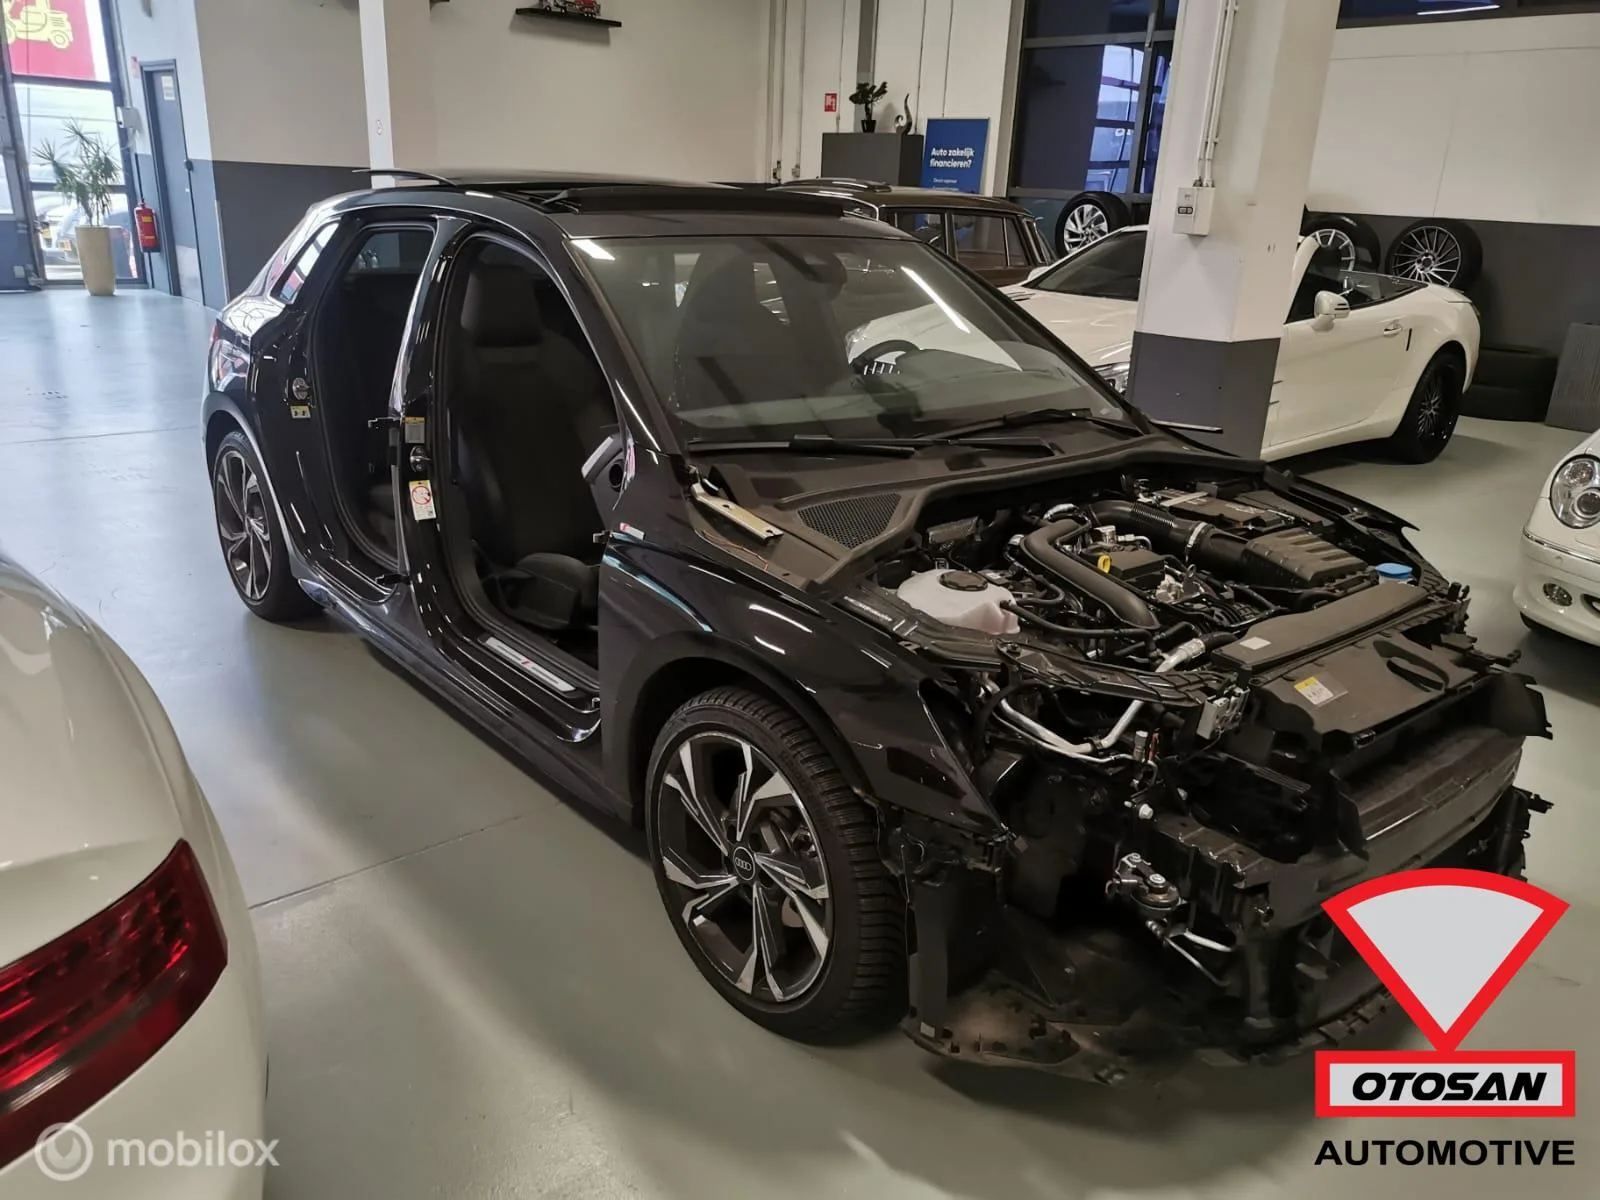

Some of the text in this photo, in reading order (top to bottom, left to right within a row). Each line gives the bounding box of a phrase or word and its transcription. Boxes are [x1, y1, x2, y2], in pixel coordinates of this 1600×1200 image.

[931, 147, 975, 159] Auto zakelijk
[929, 158, 972, 169] financieren?
